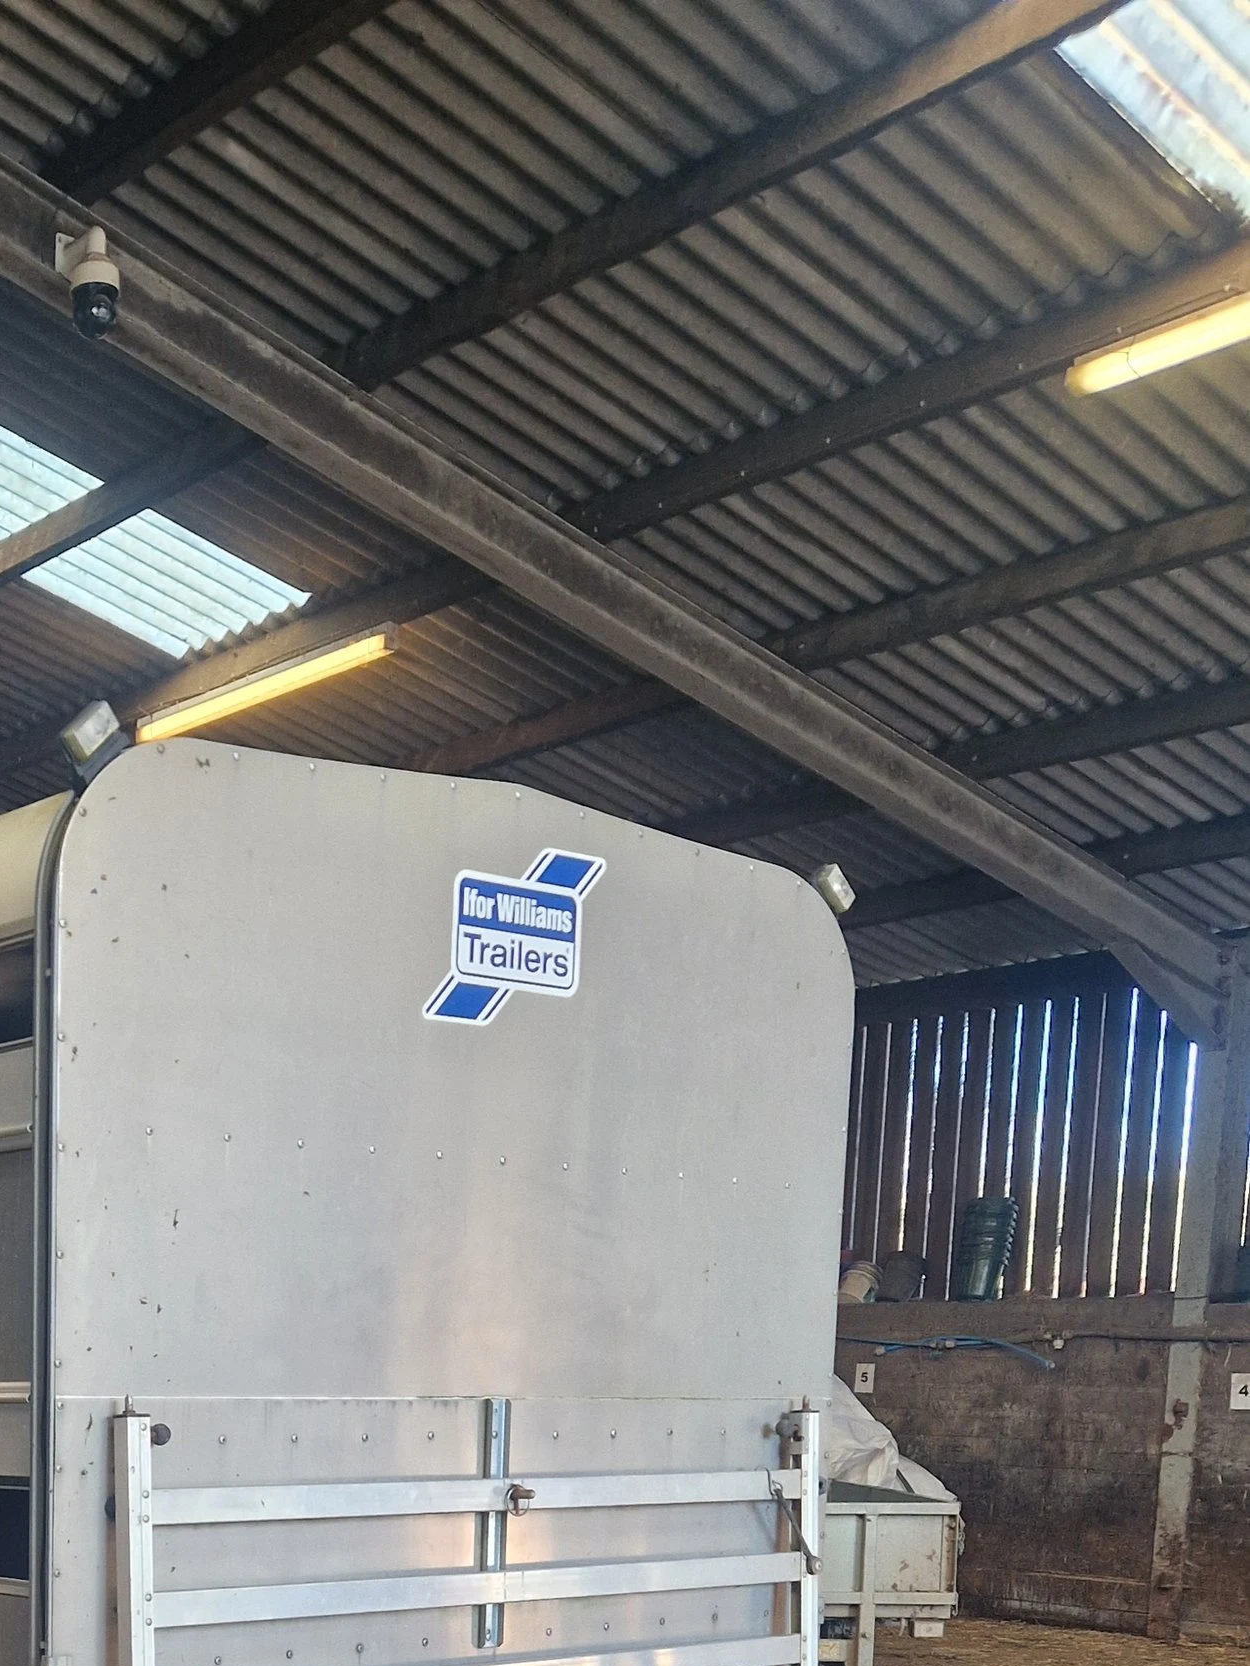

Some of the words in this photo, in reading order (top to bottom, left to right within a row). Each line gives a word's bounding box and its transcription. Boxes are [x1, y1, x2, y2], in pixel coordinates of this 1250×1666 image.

[462, 886, 496, 920] Ifor
[497, 892, 573, 934] Williams
[463, 932, 569, 978] Trailers
[860, 1371, 869, 1383] 5
[1238, 1384, 1249, 1397] 4
